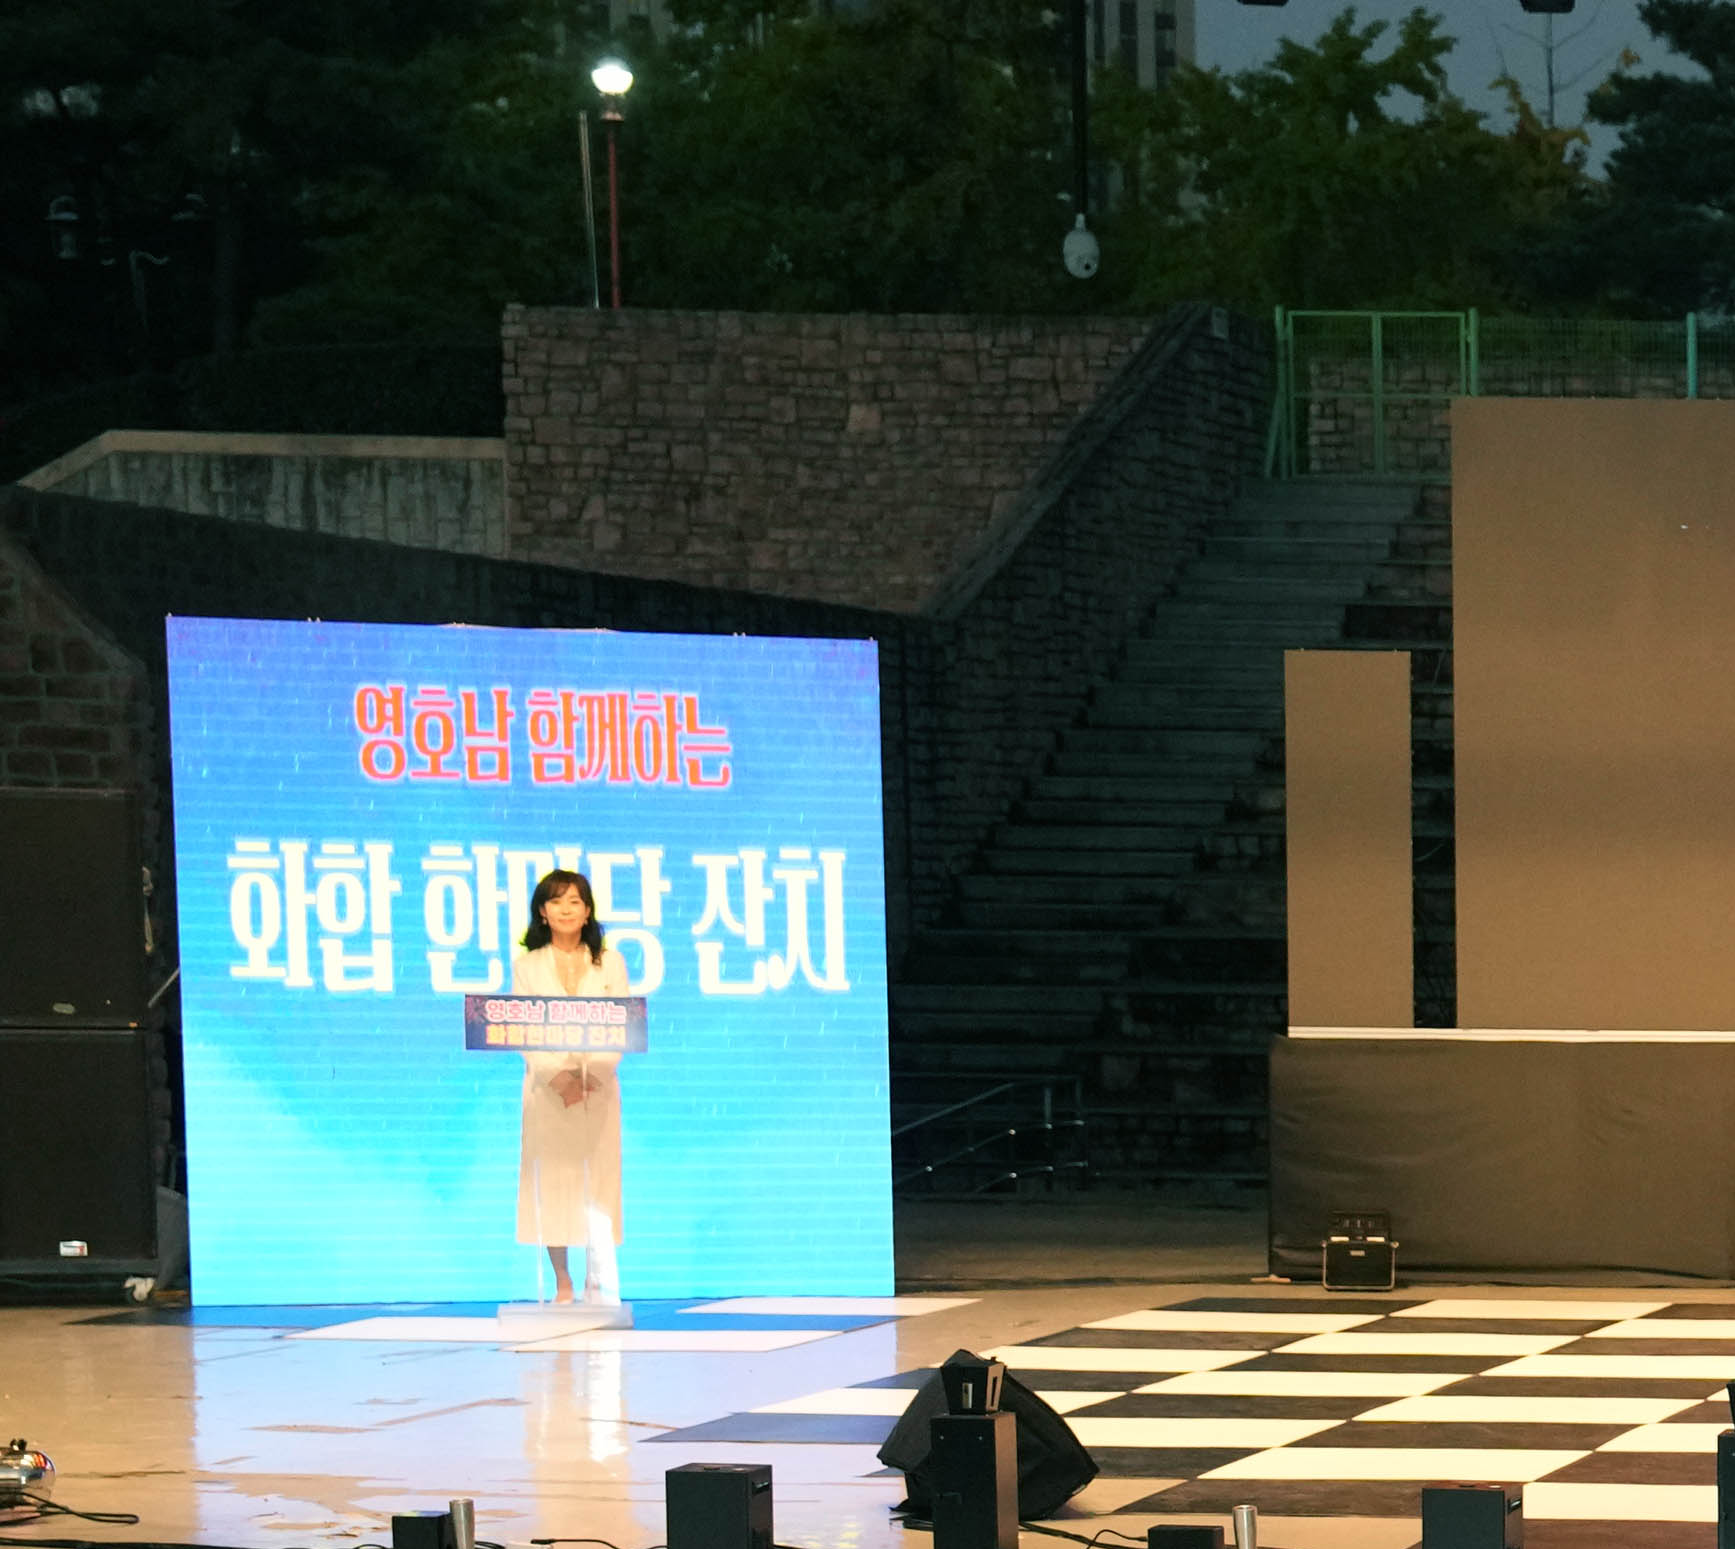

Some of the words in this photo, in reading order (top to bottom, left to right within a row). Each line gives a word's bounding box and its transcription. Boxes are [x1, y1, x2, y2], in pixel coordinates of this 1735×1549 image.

[355, 685, 516, 783] 영호남
[528, 690, 733, 788] 함께하는
[226, 839, 401, 995] 화합
[691, 847, 851, 997] 잔치
[485, 1000, 545, 1022] 영호남
[548, 1001, 627, 1025] 함께하는
